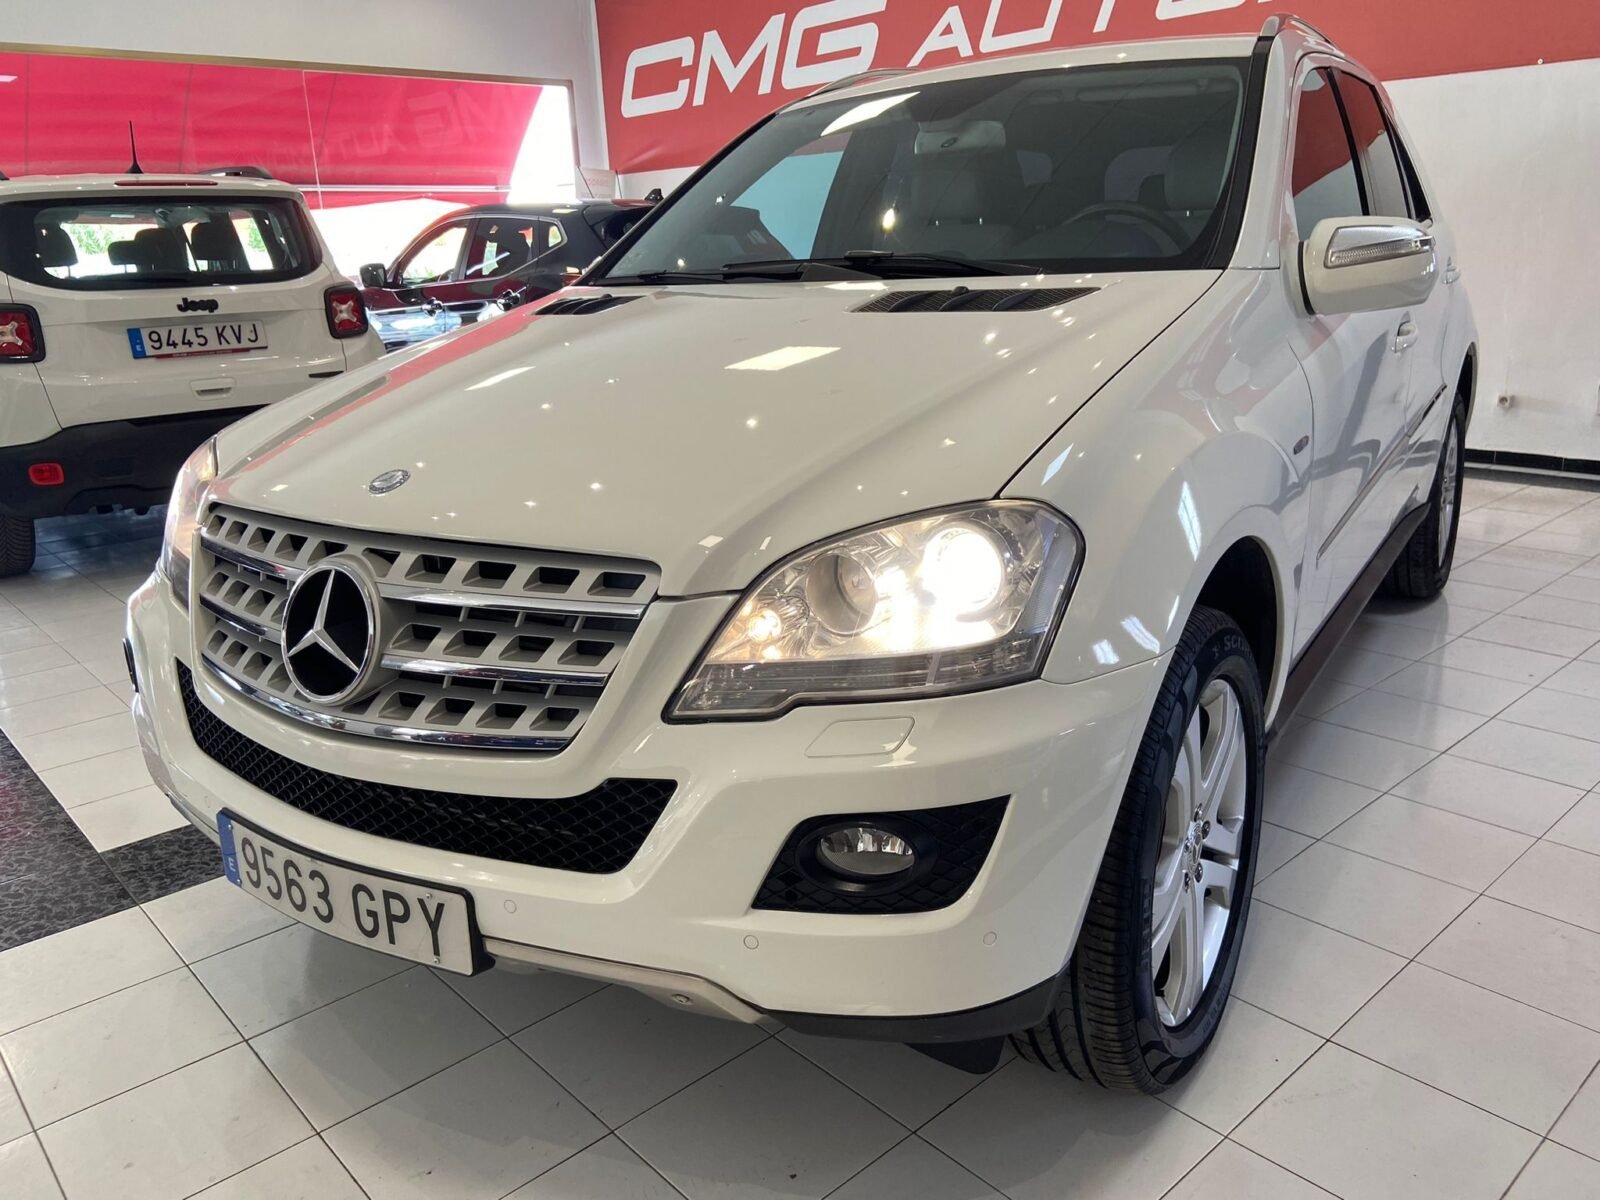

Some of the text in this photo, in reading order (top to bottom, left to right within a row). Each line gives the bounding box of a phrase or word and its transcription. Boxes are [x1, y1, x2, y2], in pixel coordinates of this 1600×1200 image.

[621, 0, 886, 118] CMG
[148, 327, 208, 350] 9445
[215, 323, 259, 345] KVJ
[177, 297, 219, 313] Jeep
[227, 836, 446, 956] E 9563 GPY
